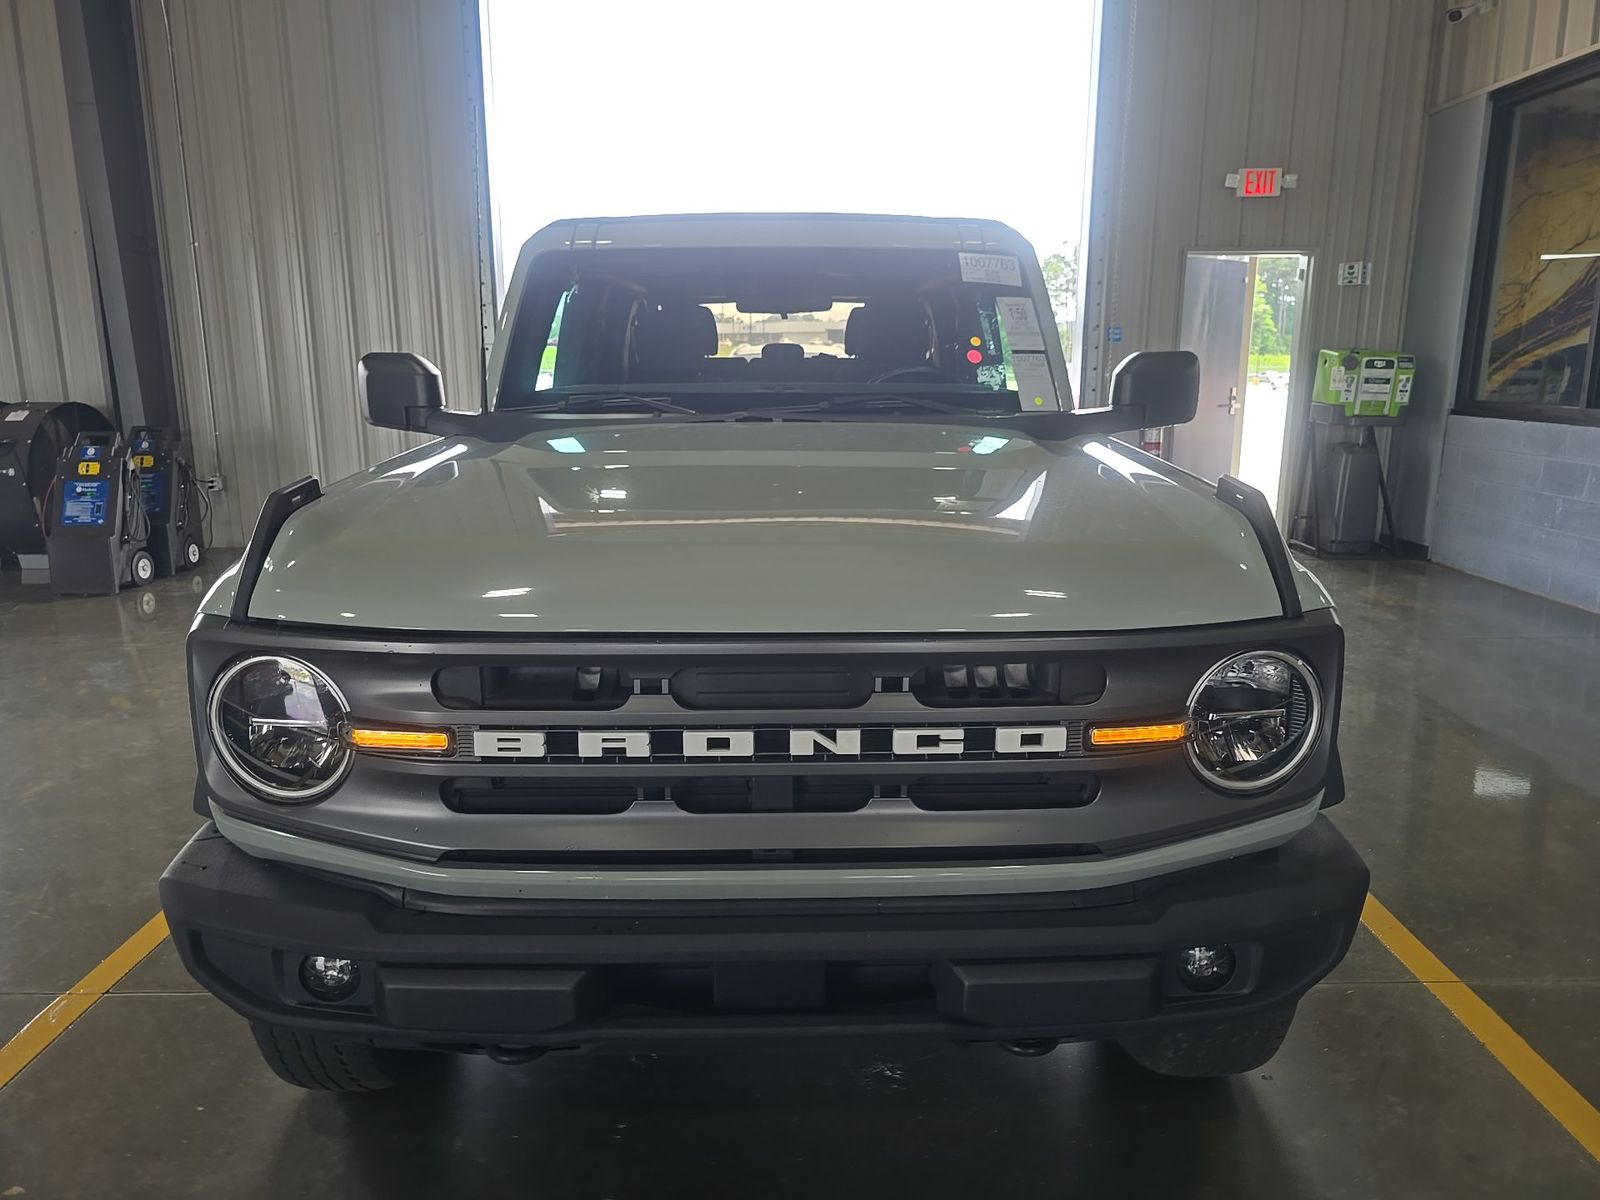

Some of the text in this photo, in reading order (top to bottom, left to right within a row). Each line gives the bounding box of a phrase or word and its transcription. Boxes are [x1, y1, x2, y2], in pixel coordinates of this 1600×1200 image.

[1244, 170, 1277, 195] EXIT
[962, 255, 1016, 271] 1007763
[472, 725, 1068, 758] BRONCO
